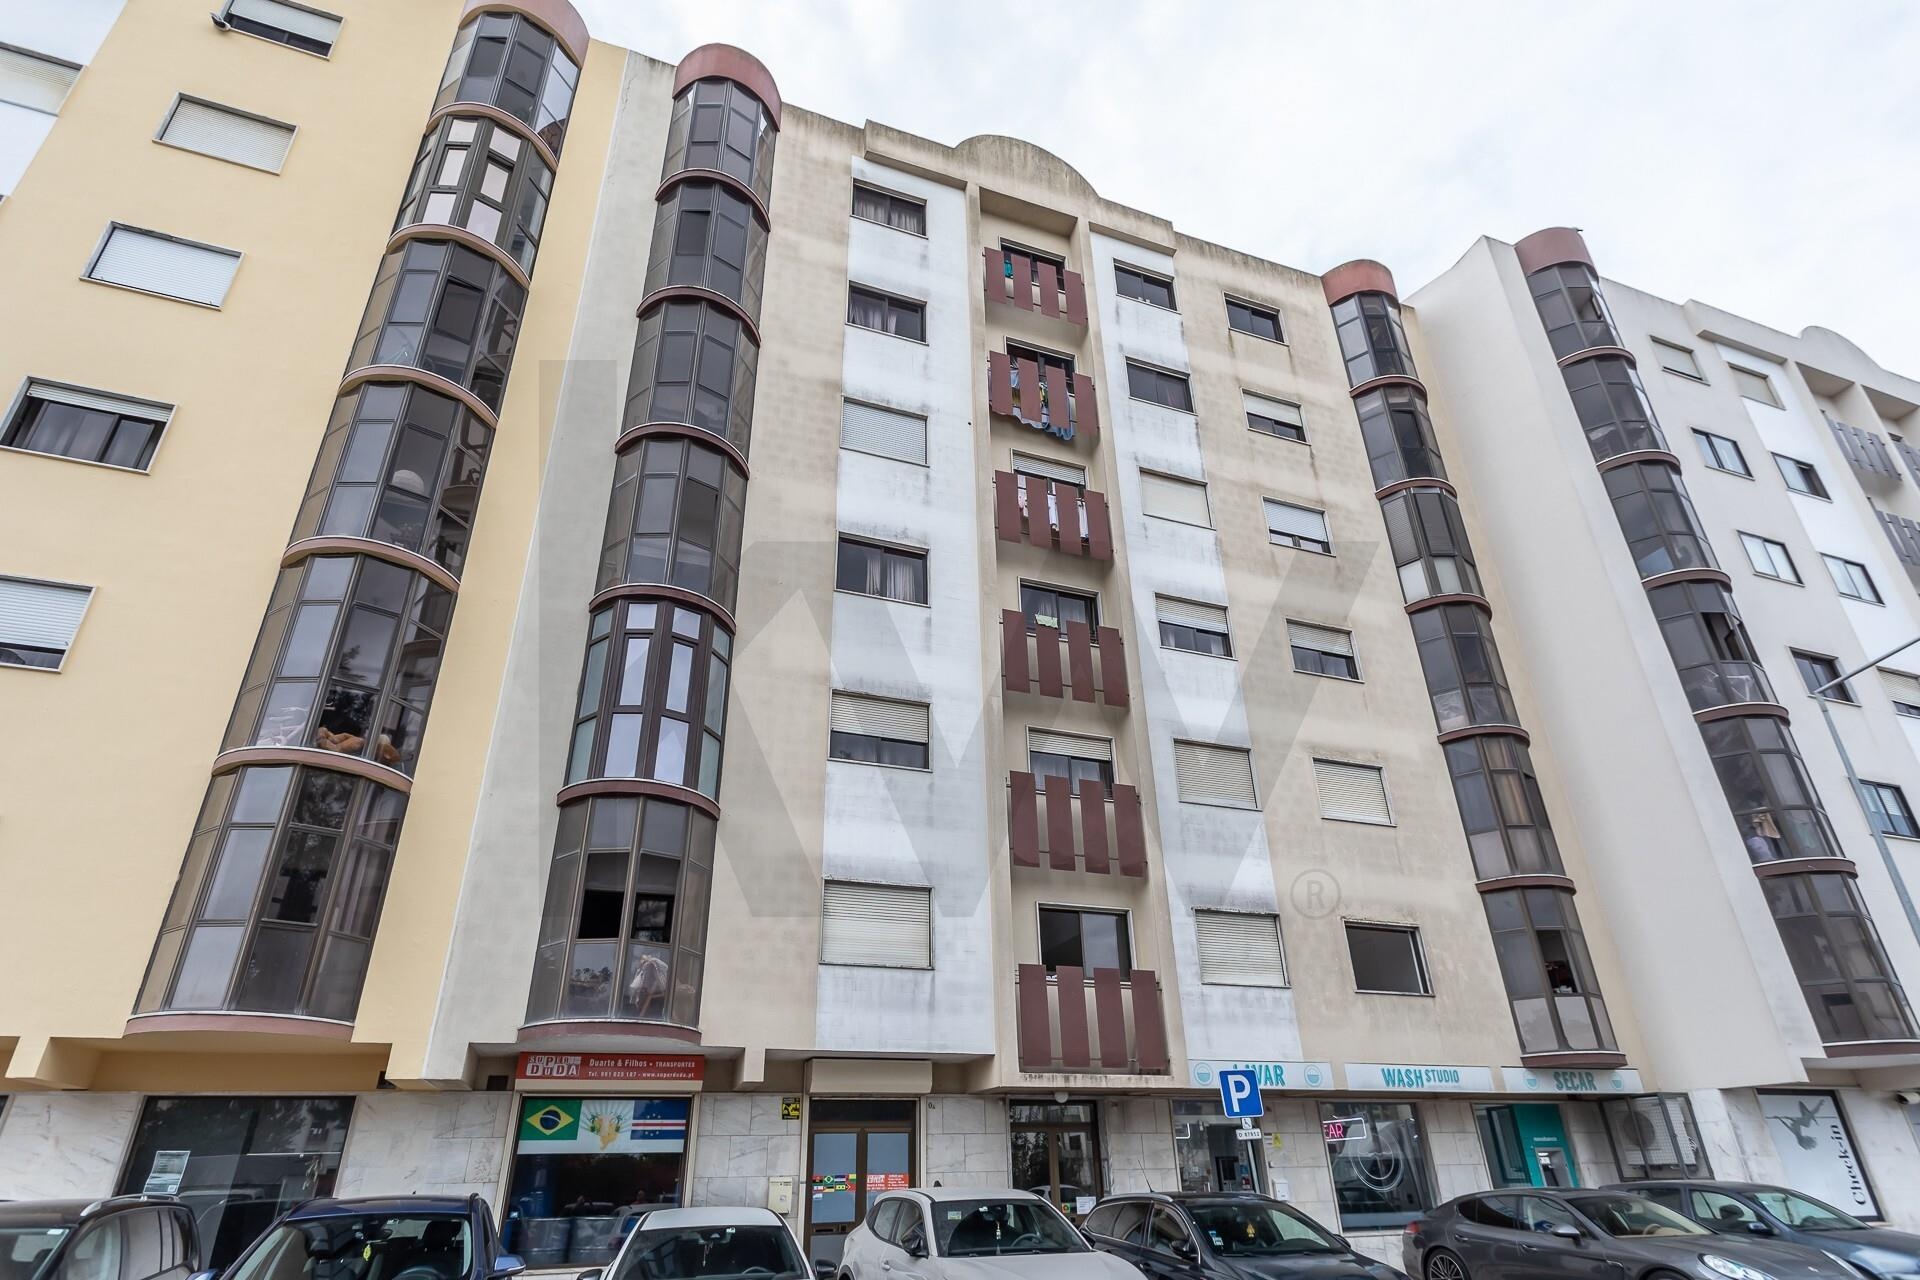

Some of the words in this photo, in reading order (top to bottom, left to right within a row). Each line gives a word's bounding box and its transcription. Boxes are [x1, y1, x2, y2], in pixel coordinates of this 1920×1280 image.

[589, 1058, 615, 1067] Duarte
[616, 1059, 623, 1067] &
[624, 1059, 647, 1067] Filhos
[1233, 1064, 1286, 1087] VAR
[1381, 1067, 1425, 1089] WASH
[1424, 1069, 1460, 1084] STUDIO
[1553, 1071, 1597, 1091] SECAR
[1227, 1074, 1251, 1113] P
[1830, 1124, 1866, 1205] Check-in
